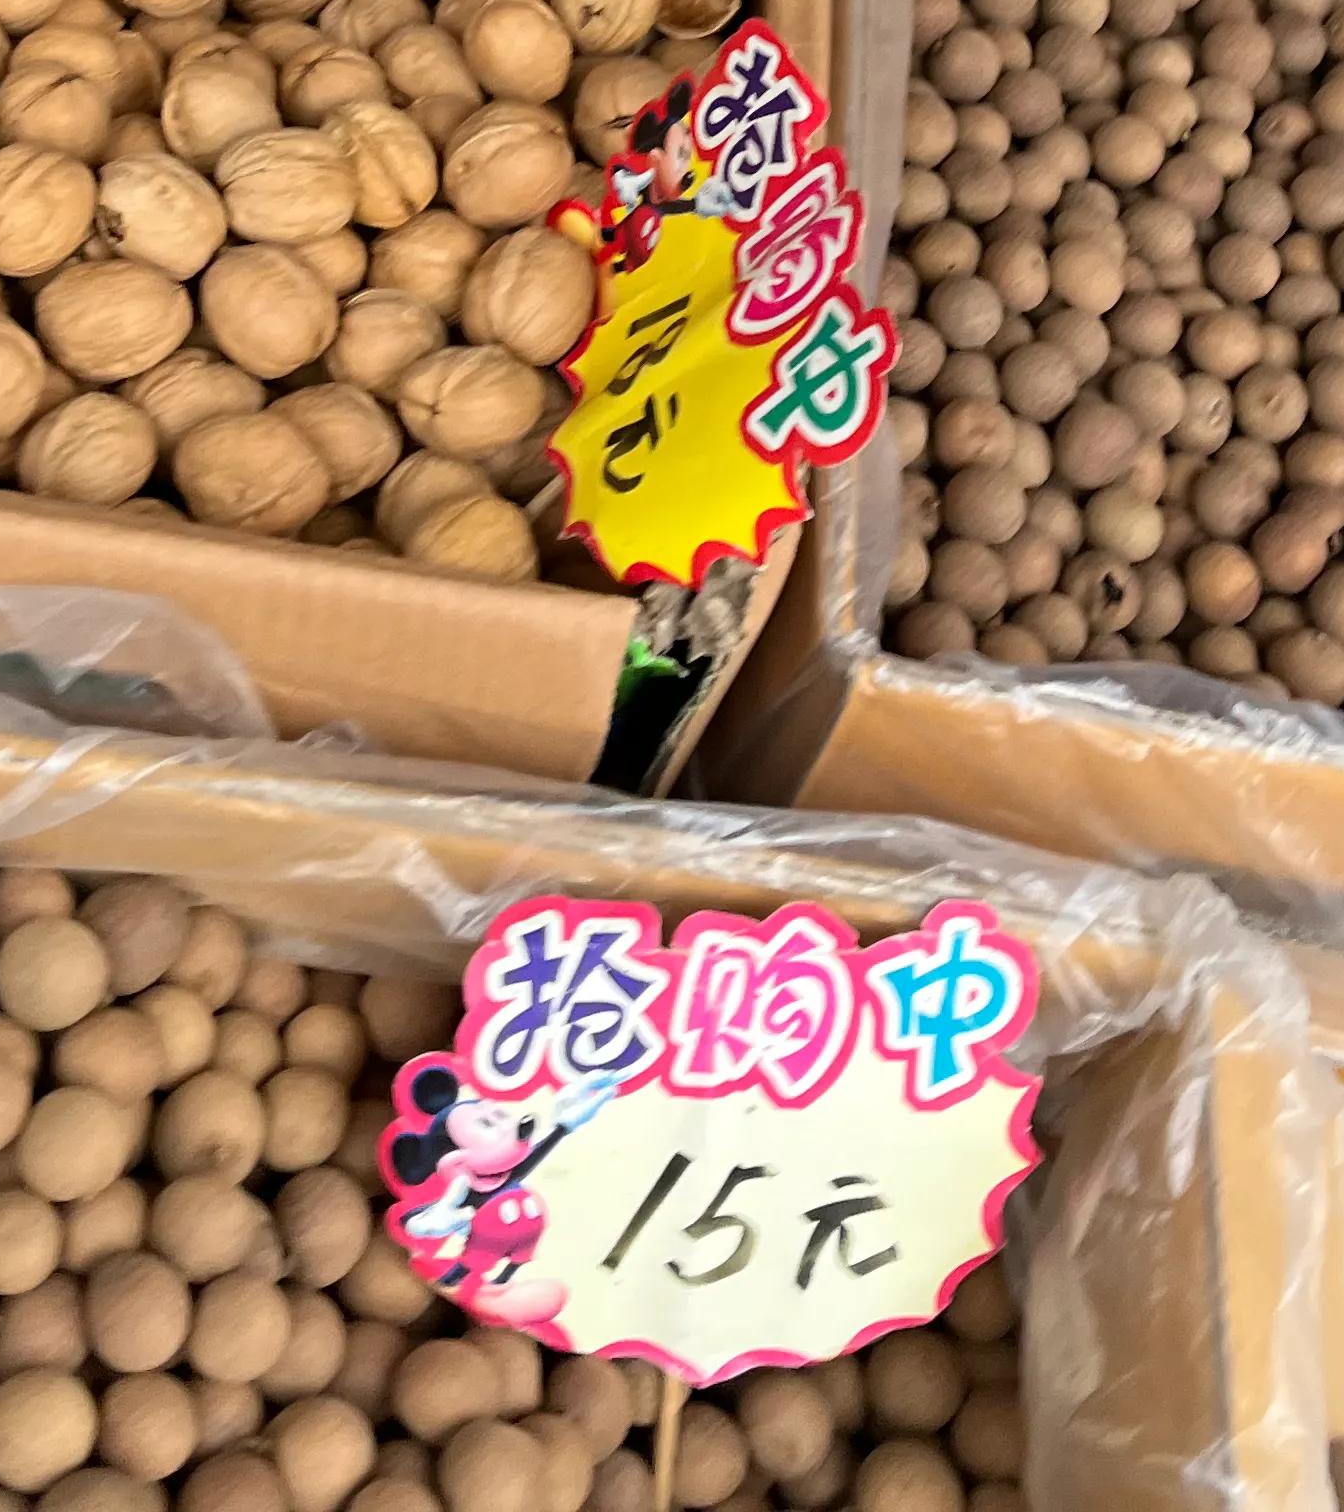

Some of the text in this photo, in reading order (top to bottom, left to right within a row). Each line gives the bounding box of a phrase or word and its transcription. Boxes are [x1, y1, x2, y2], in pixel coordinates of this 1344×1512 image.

[701, 48, 875, 438] 抢购中
[490, 922, 1009, 1090] 抢购中
[599, 1152, 899, 1290] 15元
